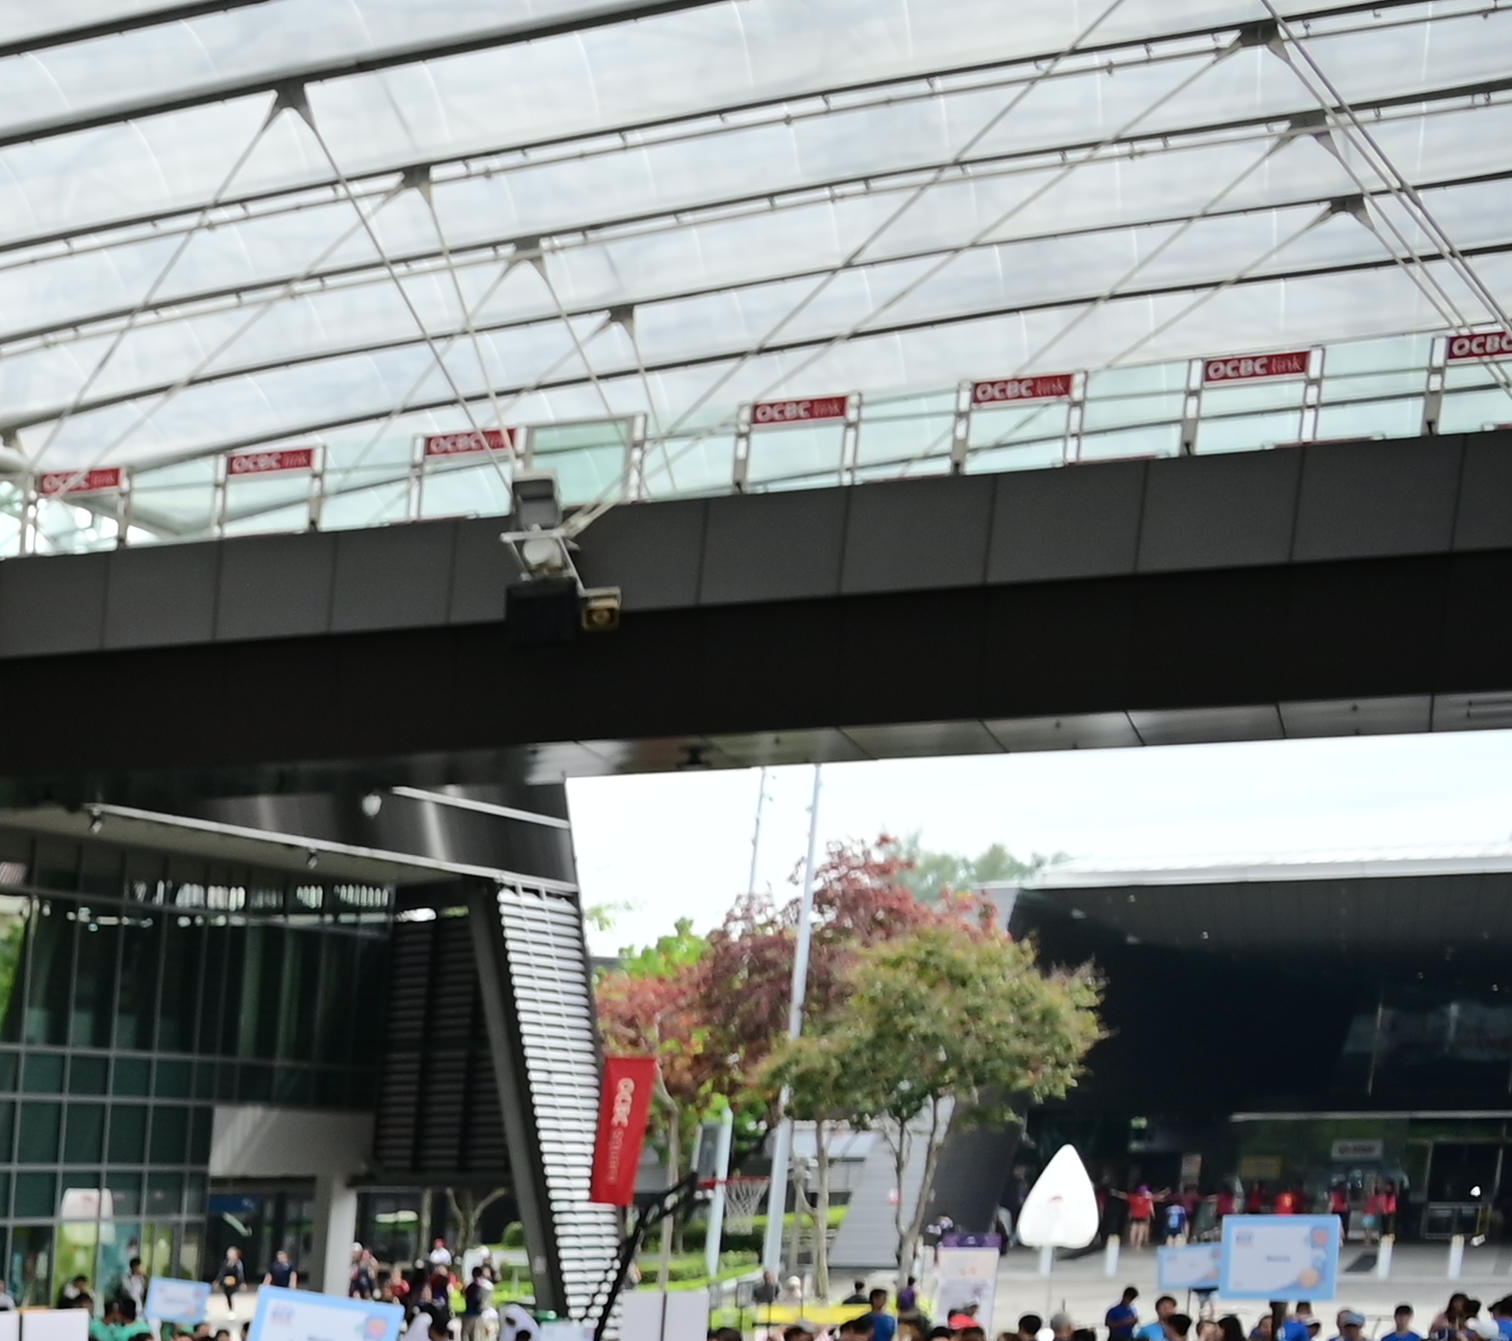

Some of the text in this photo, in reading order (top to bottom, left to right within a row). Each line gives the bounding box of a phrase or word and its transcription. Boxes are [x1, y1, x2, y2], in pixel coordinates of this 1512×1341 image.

[1452, 331, 1512, 355] OCBC
[1207, 354, 1302, 379] OCBC link
[976, 380, 1033, 401] OCBC
[756, 401, 810, 422] OCBC
[232, 453, 281, 474] OCBC
[611, 1077, 635, 1128] OCBC
